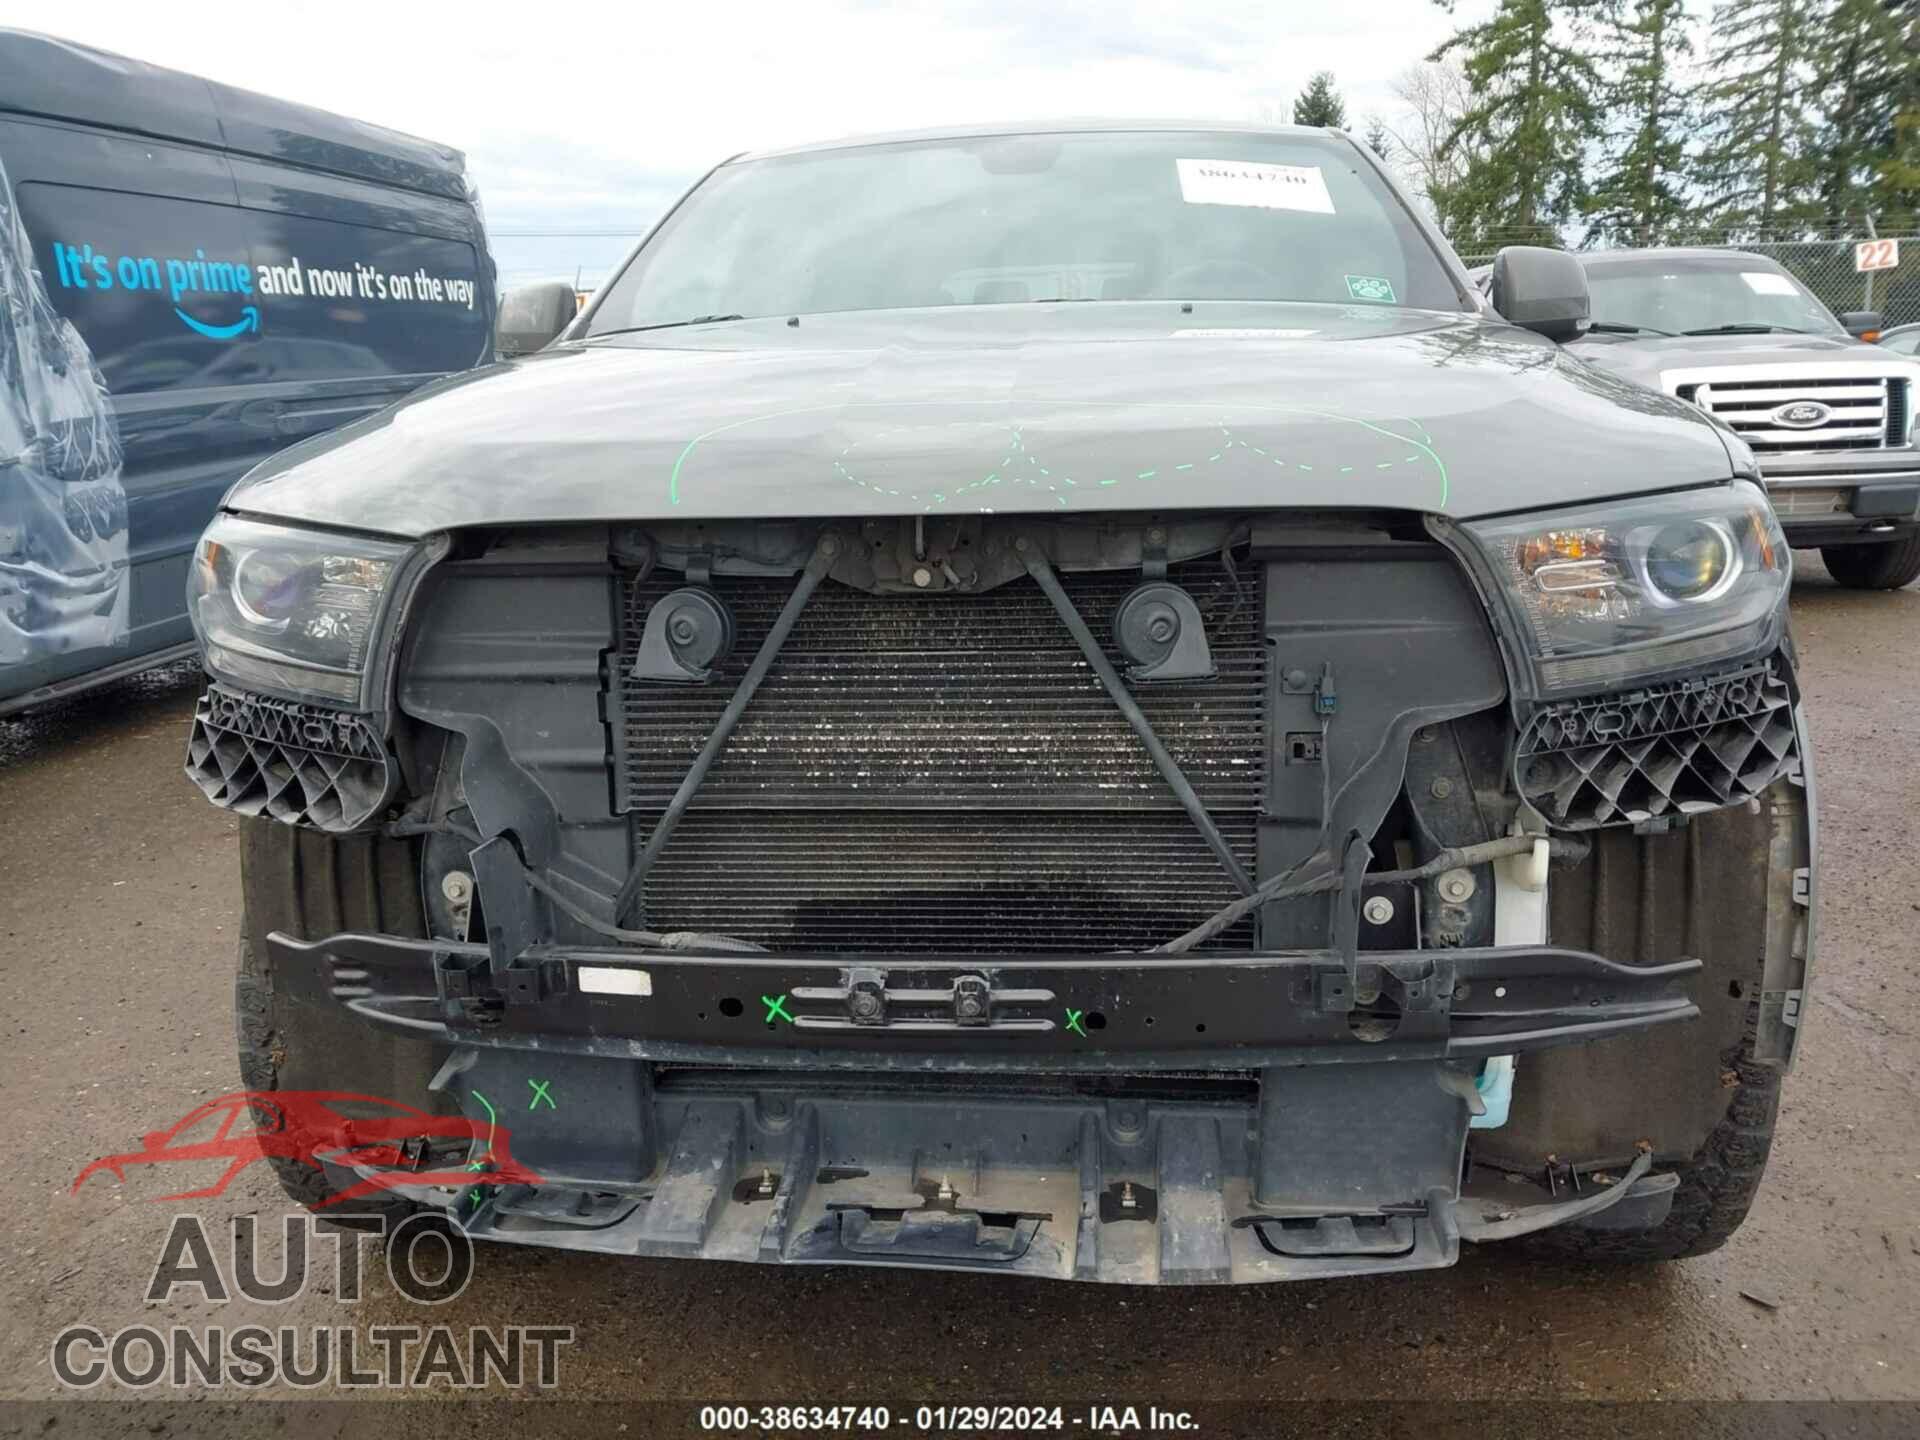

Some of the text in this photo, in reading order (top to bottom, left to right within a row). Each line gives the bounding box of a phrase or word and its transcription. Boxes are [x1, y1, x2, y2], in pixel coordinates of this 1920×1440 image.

[1860, 241, 1894, 269] 22
[54, 241, 476, 311] It's on prime and now it's on the way
[1788, 407, 1819, 420] Ford
